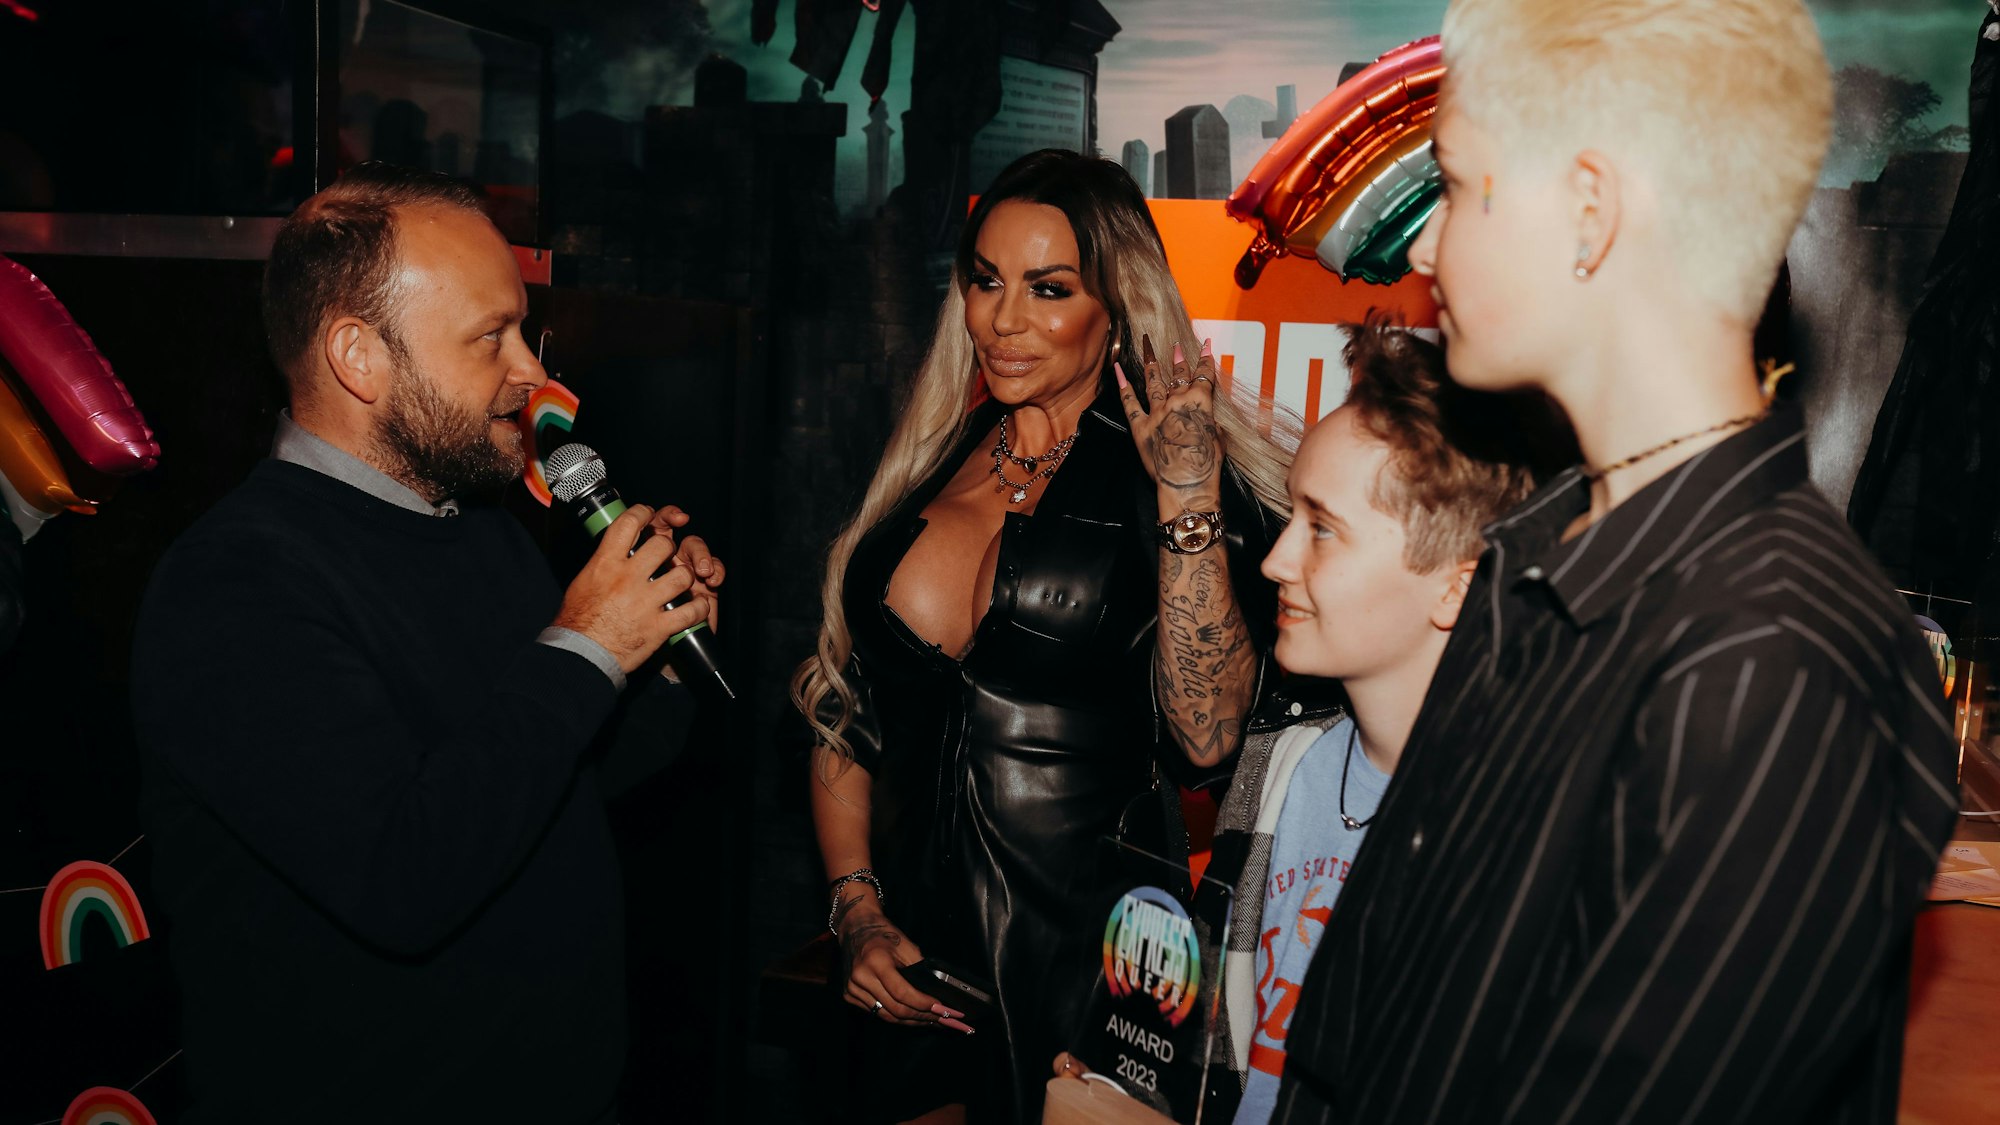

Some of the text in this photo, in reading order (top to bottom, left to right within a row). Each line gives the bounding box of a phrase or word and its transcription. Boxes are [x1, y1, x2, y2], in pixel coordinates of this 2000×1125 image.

[1191, 557, 1222, 613] Queen
[1193, 709, 1208, 726] &
[1268, 856, 1351, 900] TED STATE
[1115, 958, 1182, 1009] QUEER
[1106, 1013, 1174, 1064] AWARD
[1116, 1054, 1157, 1092] 2023
